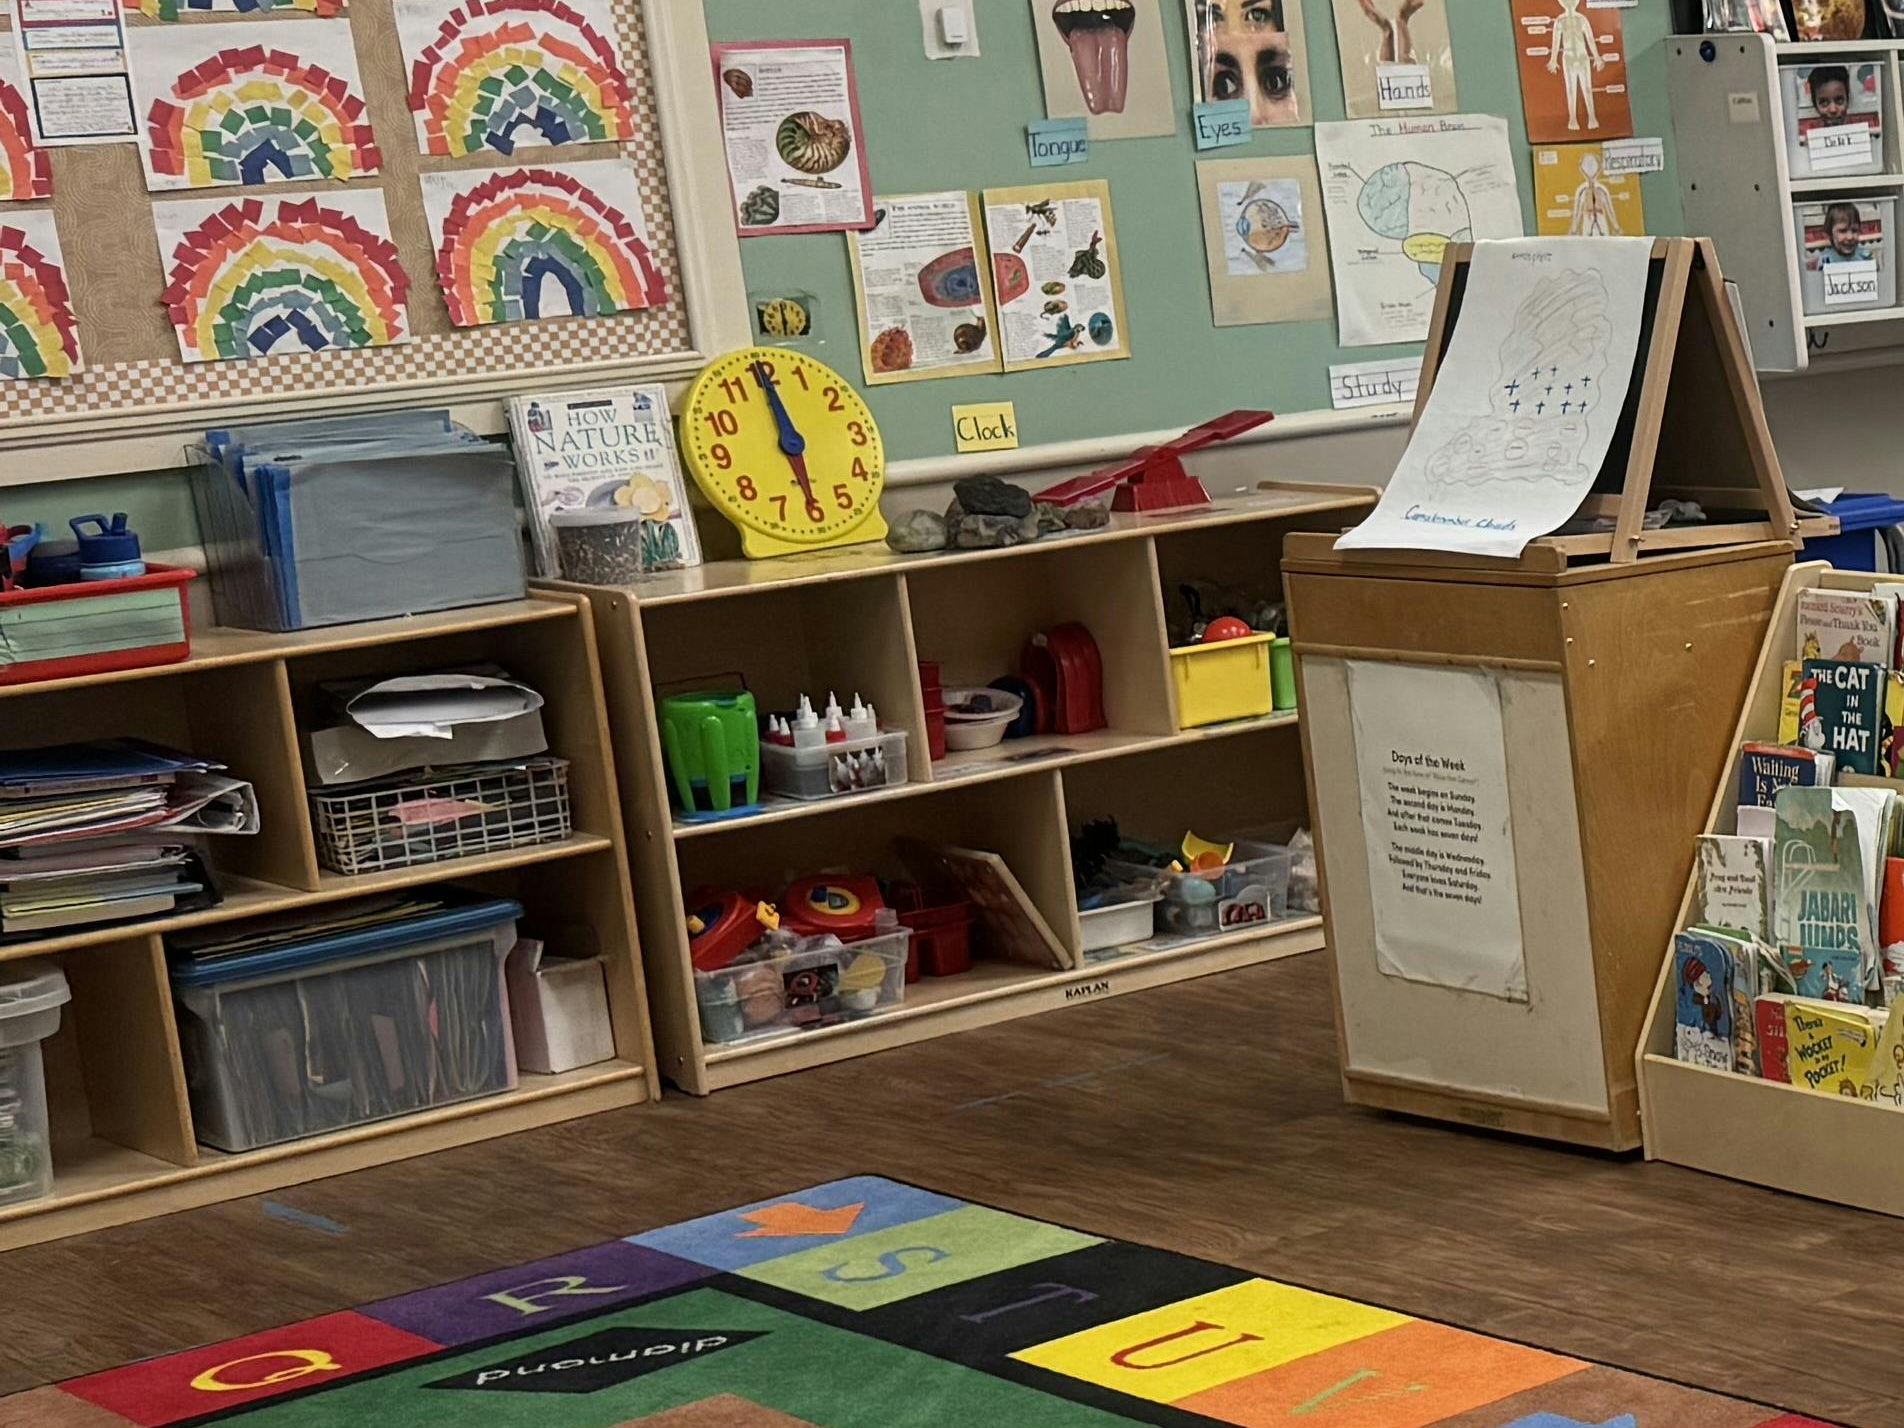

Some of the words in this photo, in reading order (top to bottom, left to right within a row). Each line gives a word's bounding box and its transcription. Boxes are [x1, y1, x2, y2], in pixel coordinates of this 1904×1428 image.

[1379, 70, 1432, 102] Hands
[1197, 115, 1242, 141] Eyes
[1028, 130, 1088, 162] Tongue
[1826, 274, 1877, 297] Jackson
[718, 376, 750, 405] 11
[792, 365, 809, 391] 1
[1341, 376, 1402, 402] Study
[823, 386, 845, 412] 2
[567, 406, 619, 428] HOW
[704, 409, 739, 437] 10
[955, 413, 1016, 442] Clock
[534, 420, 661, 455] NATURE
[847, 421, 868, 447] 3
[561, 448, 642, 470] WORKS
[711, 443, 733, 470] 9
[851, 456, 869, 482] 4
[736, 475, 758, 502] 8
[833, 483, 853, 510] 5
[769, 494, 789, 521] 7
[1811, 668, 1833, 685] THE
[1834, 665, 1870, 691] CAT
[1846, 694, 1859, 708] IN
[1841, 711, 1862, 725] THE
[1832, 725, 1870, 753] HAT
[1391, 749, 1413, 766] Days
[1413, 753, 1424, 765] of
[1425, 754, 1440, 769] the
[1440, 756, 1466, 772] Week
[1751, 755, 1800, 784] Waiting
[1755, 775, 1768, 793] Is
[1798, 890, 1858, 922] JABARI
[1064, 979, 1110, 1001] KAPLAN
[1794, 1035, 1834, 1063] WOCKET
[1804, 1054, 1847, 1089] POCKET!
[484, 1274, 630, 1316] R
[1109, 1318, 1267, 1372] U
[189, 1347, 343, 1393] Q
[474, 1334, 729, 1387] diamond
